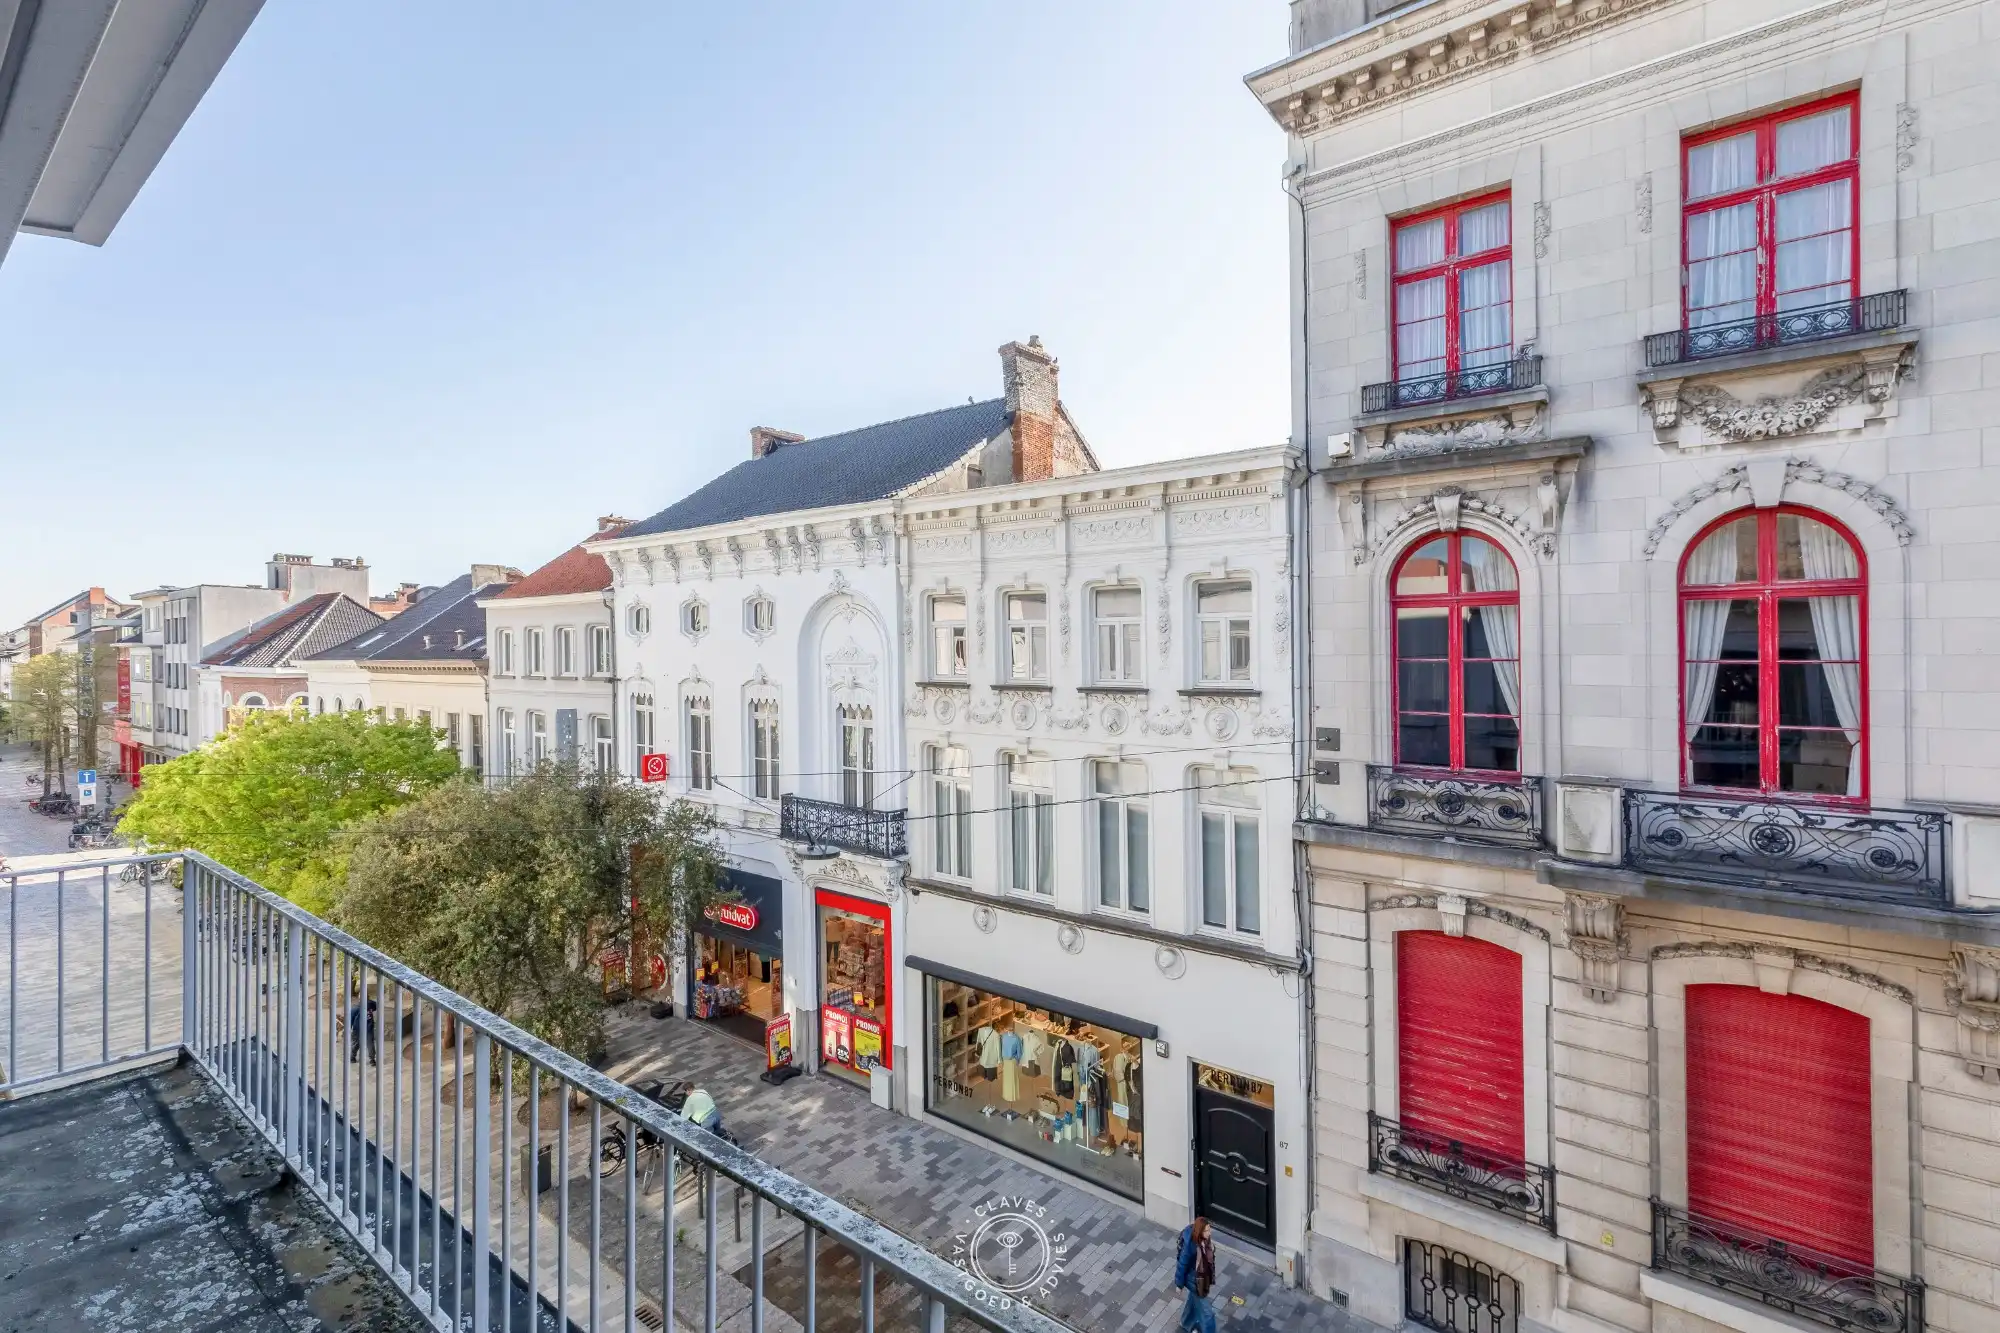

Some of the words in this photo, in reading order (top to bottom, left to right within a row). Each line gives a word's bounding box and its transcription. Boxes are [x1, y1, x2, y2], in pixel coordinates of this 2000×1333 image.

[717, 906, 751, 926] ruidvat
[825, 1009, 848, 1024] PROMO!
[855, 1019, 880, 1034] PROMO!
[933, 1074, 973, 1098] PERRON87
[1279, 1141, 1289, 1150] 87
